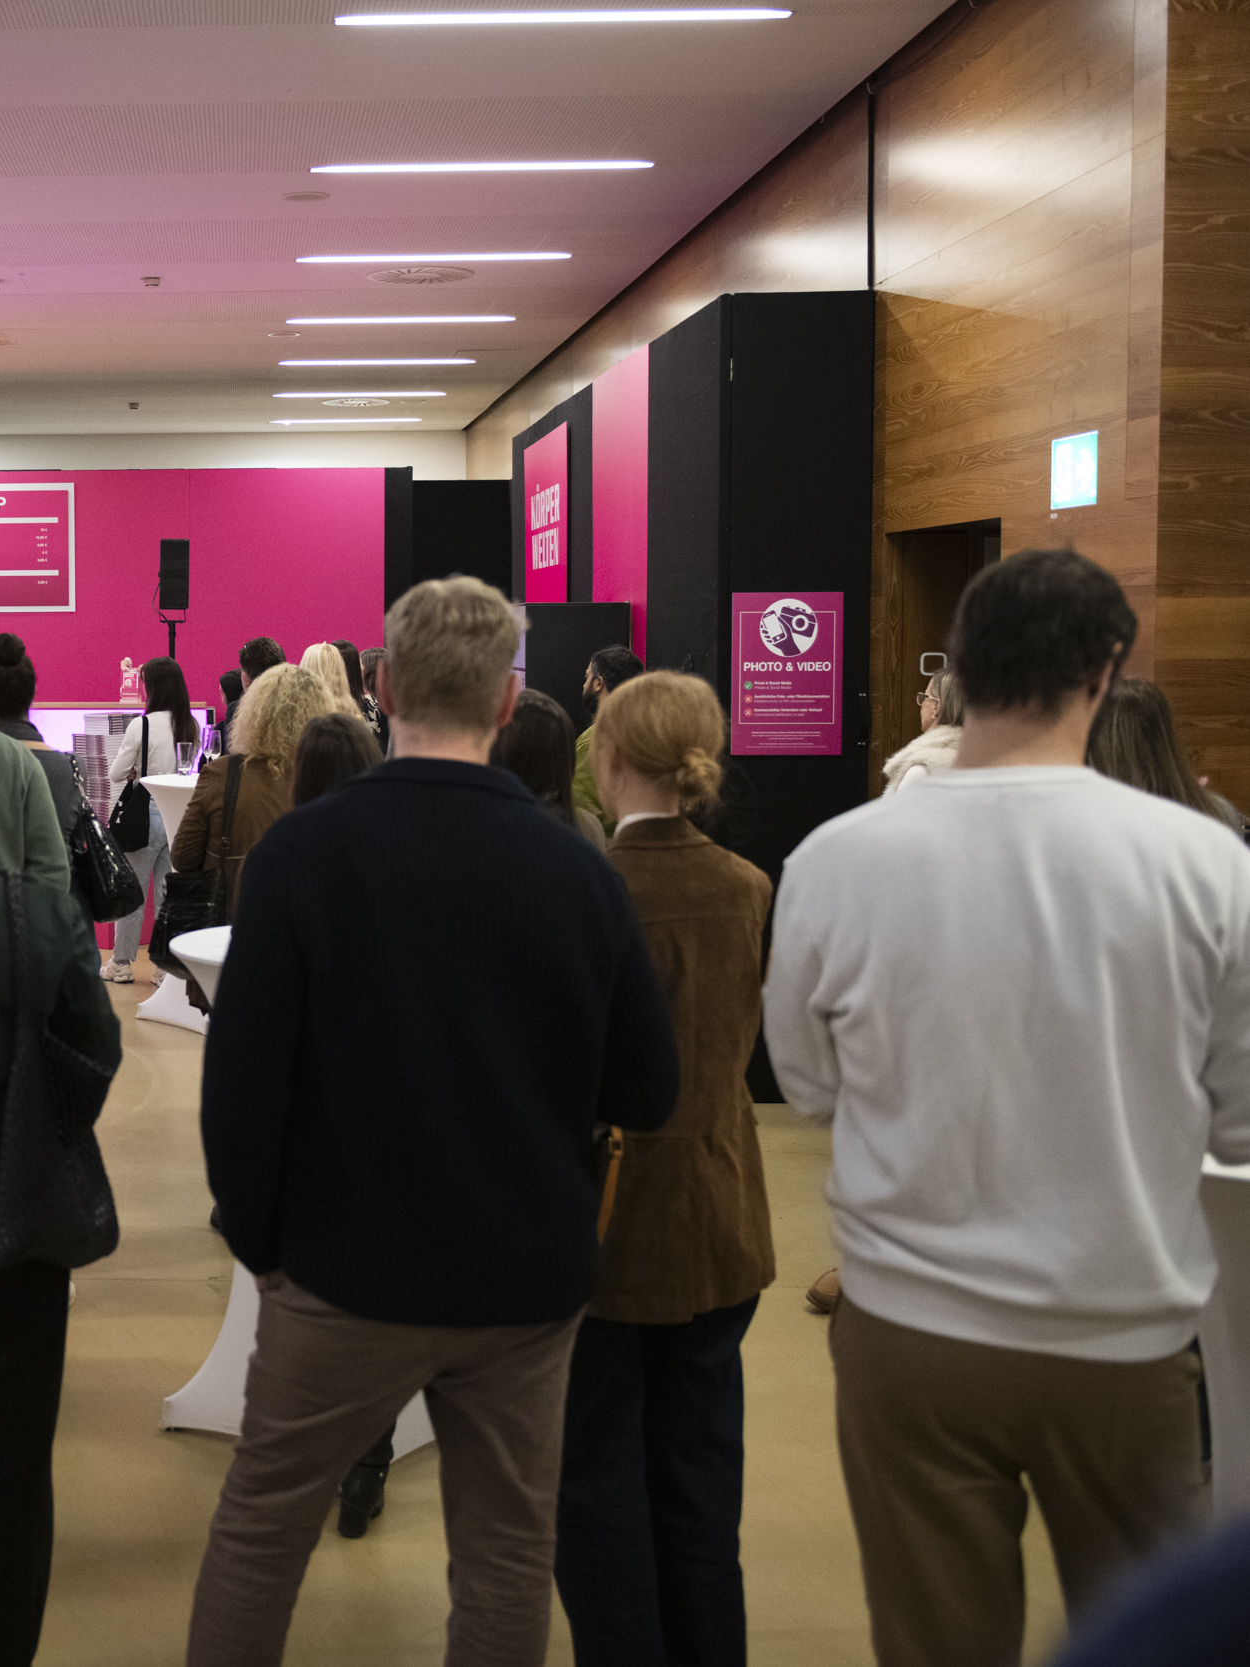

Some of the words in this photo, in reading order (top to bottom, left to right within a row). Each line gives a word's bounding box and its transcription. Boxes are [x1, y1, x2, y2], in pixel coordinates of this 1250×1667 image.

[530, 484, 560, 531] KÖRPER
[532, 527, 559, 570] WELTEN
[744, 662, 782, 672] PHOTO
[786, 662, 793, 672] &
[797, 662, 831, 671] VIDEO
